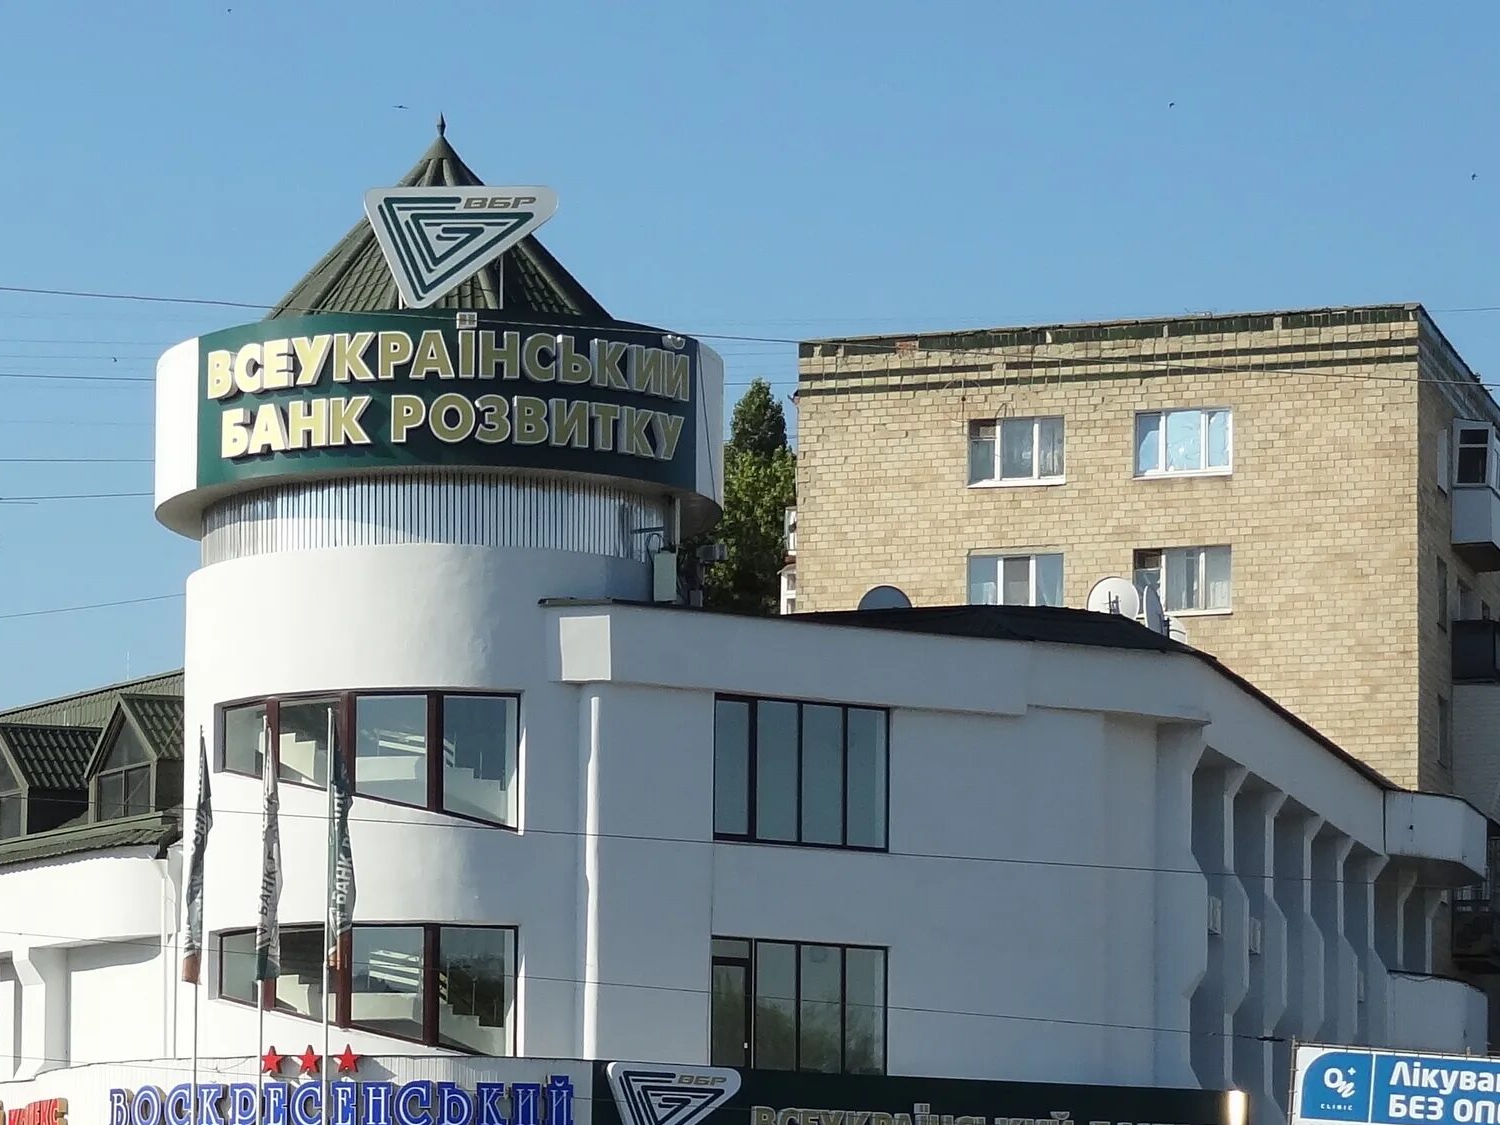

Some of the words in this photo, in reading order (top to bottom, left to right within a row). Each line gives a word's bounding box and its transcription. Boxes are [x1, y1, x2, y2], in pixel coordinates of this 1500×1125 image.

[463, 196, 537, 209] ВБР
[206, 311, 691, 402] ВСЕУКРАЇНСЬКИЙ
[220, 395, 376, 460] БАНК
[389, 392, 686, 461] РОЗВИТКУ
[677, 1074, 728, 1087] ВБР
[1320, 1103, 1353, 1111] CLINIC
[1388, 1093, 1444, 1121] БЕЗ
